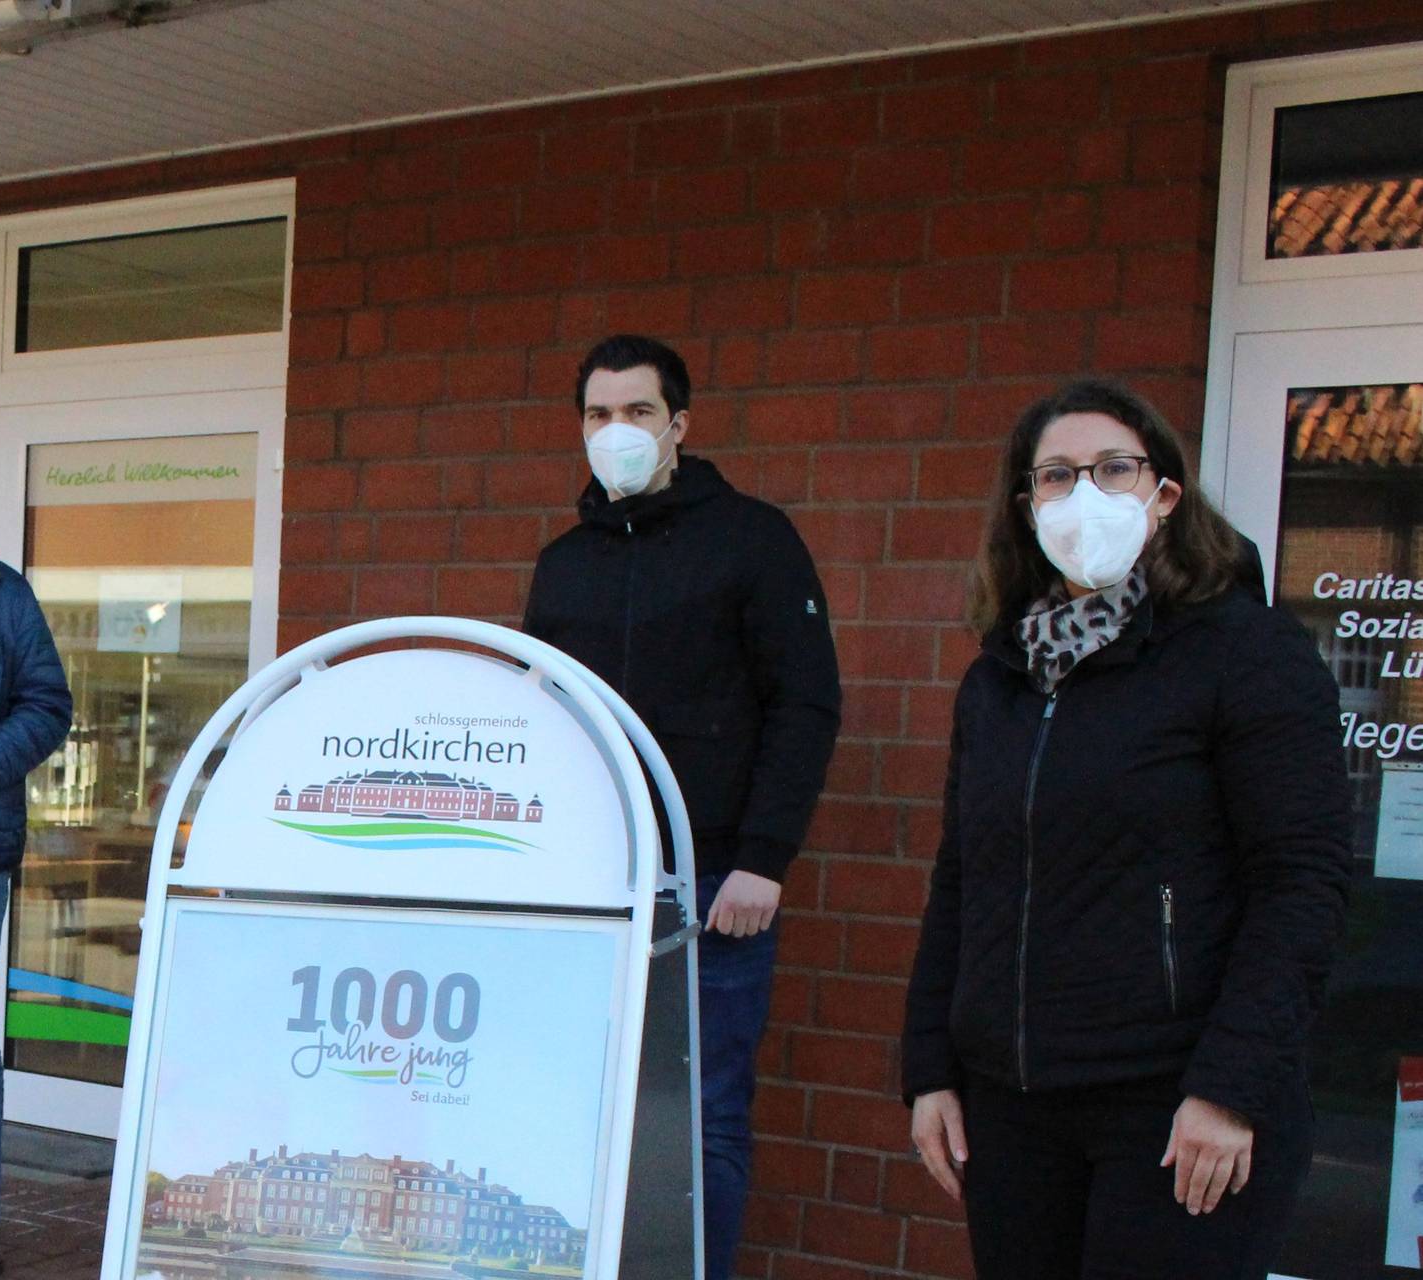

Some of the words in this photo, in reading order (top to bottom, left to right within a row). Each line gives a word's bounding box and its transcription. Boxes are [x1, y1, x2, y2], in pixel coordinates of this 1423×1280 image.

[46, 463, 116, 487] Herzlich
[124, 460, 240, 482] Willkommen
[1335, 610, 1423, 639] Sozia
[1380, 651, 1423, 678] Lü
[414, 712, 529, 729] schlossgemeinde
[322, 728, 527, 764] nordkirchen
[286, 965, 481, 1044] 1000
[291, 1023, 401, 1079] Jahre
[400, 1042, 474, 1089] jung
[410, 1090, 429, 1103] Sei
[432, 1091, 470, 1106] dabei!
